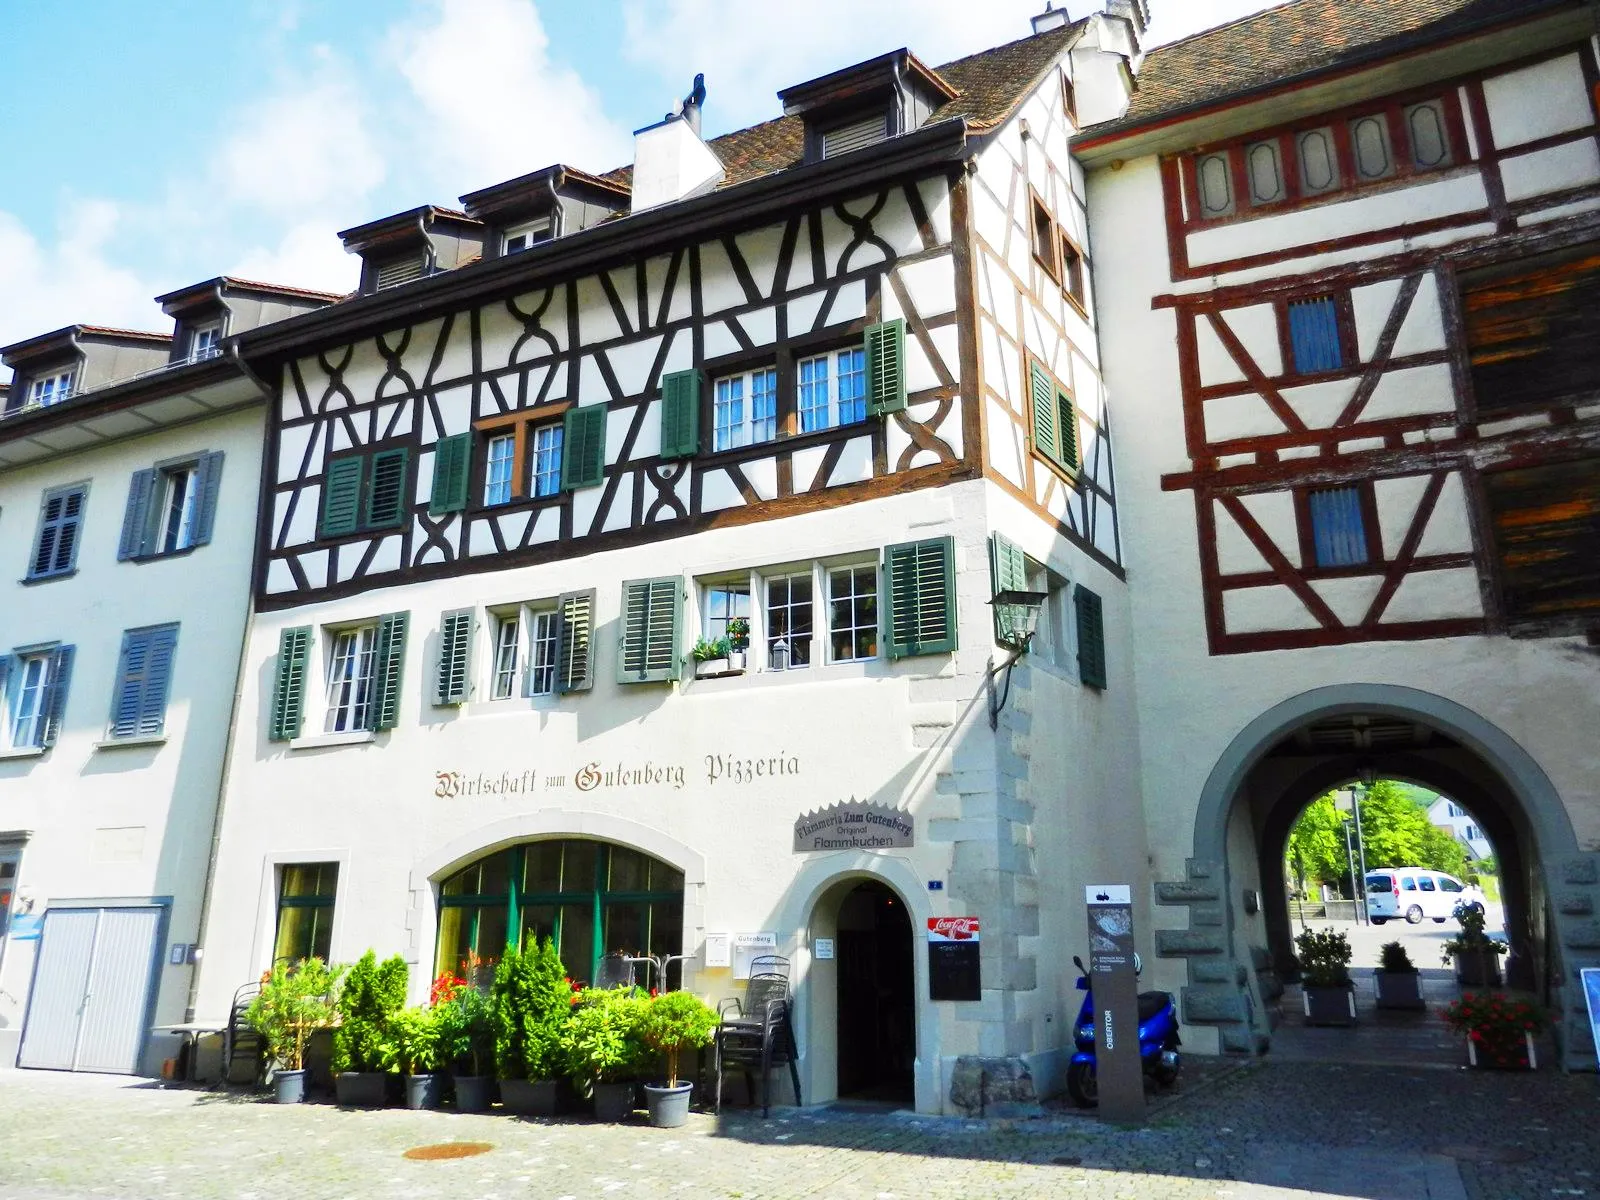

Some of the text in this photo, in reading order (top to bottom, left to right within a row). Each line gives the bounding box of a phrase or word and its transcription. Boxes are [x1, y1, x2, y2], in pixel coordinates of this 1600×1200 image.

[435, 751, 801, 798] Wirtschaft zum Gutenberg Pizzeria
[837, 826, 868, 836] Original
[843, 812, 864, 823] Zum
[866, 812, 912, 836] Gutenberg
[814, 836, 894, 848] Flammkuchen
[1104, 1010, 1114, 1049] OBERTOR
